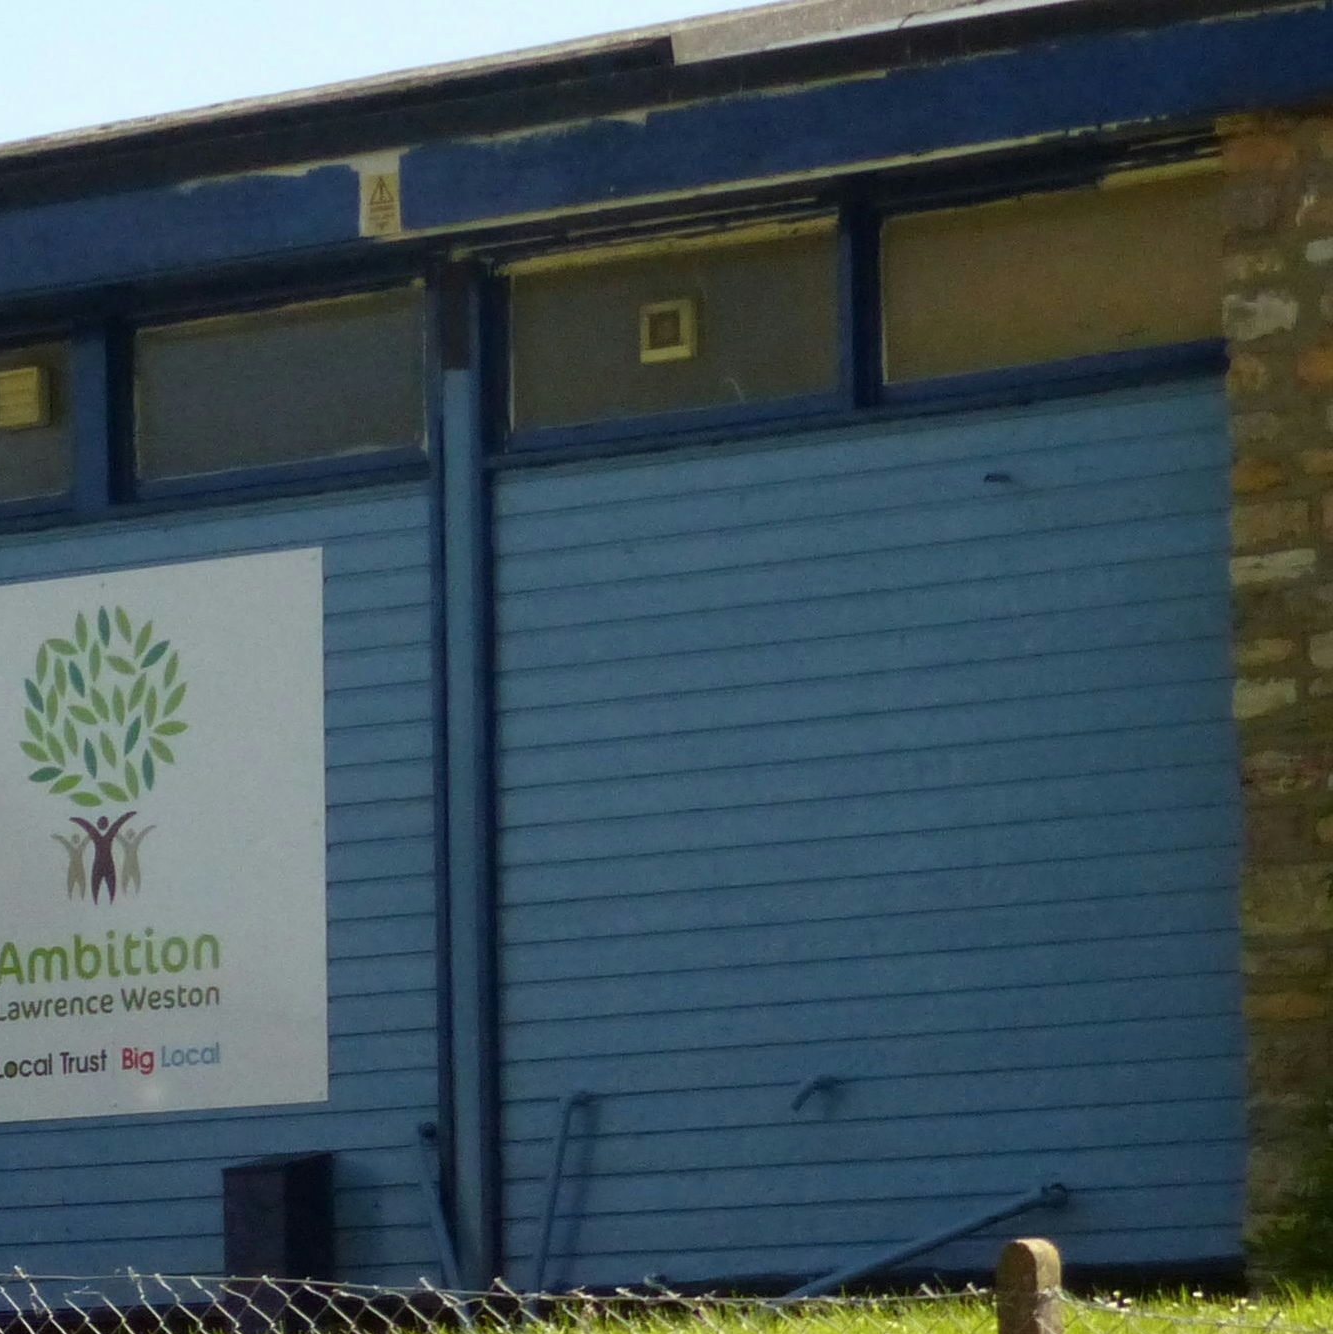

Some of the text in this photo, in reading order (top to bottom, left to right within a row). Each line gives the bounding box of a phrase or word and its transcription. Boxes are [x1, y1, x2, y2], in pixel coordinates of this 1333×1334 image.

[121, 985, 220, 1010] Weston
[60, 1050, 108, 1075] Trust
[121, 1047, 155, 1075] Big
[161, 1042, 221, 1068] Local
